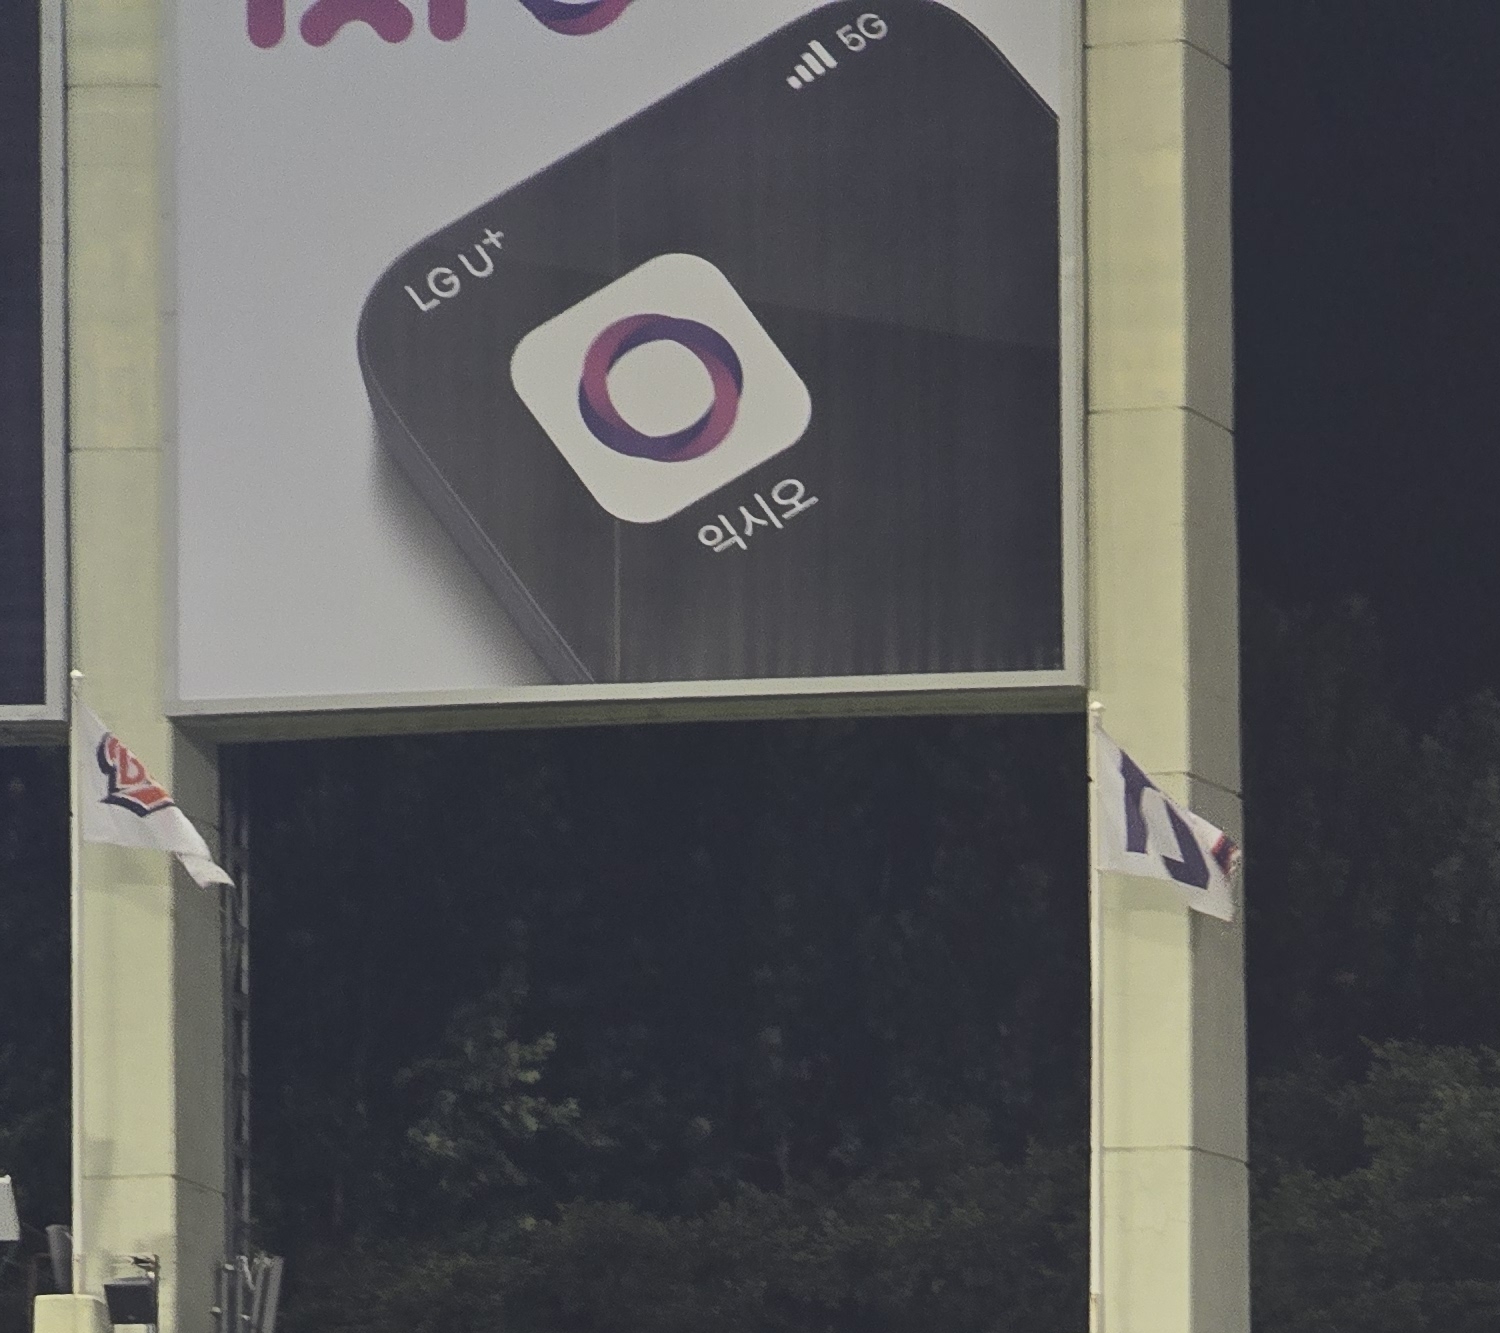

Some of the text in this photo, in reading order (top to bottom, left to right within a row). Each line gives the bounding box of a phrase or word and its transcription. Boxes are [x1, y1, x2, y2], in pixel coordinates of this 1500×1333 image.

[835, 12, 889, 52] 5G
[403, 227, 505, 312] LG U+
[697, 478, 820, 553] 익시오
